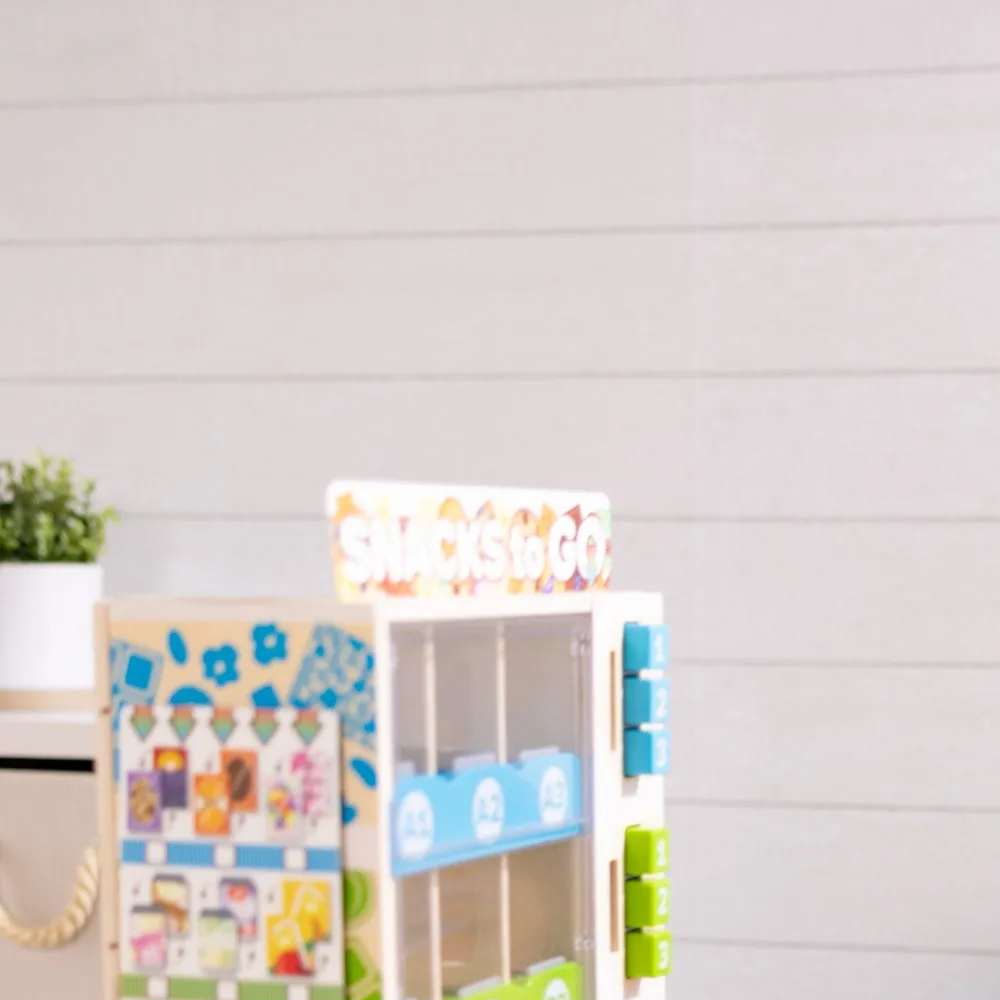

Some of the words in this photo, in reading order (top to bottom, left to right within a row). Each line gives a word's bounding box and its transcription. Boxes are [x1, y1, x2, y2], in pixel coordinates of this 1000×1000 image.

[339, 515, 506, 582] SNACKS
[509, 525, 544, 579] to
[654, 632, 664, 664] 1
[656, 687, 668, 718] 2
[477, 793, 501, 822] A2
[655, 839, 667, 867] 1
[657, 887, 668, 916] 2
[658, 940, 669, 970] 3
